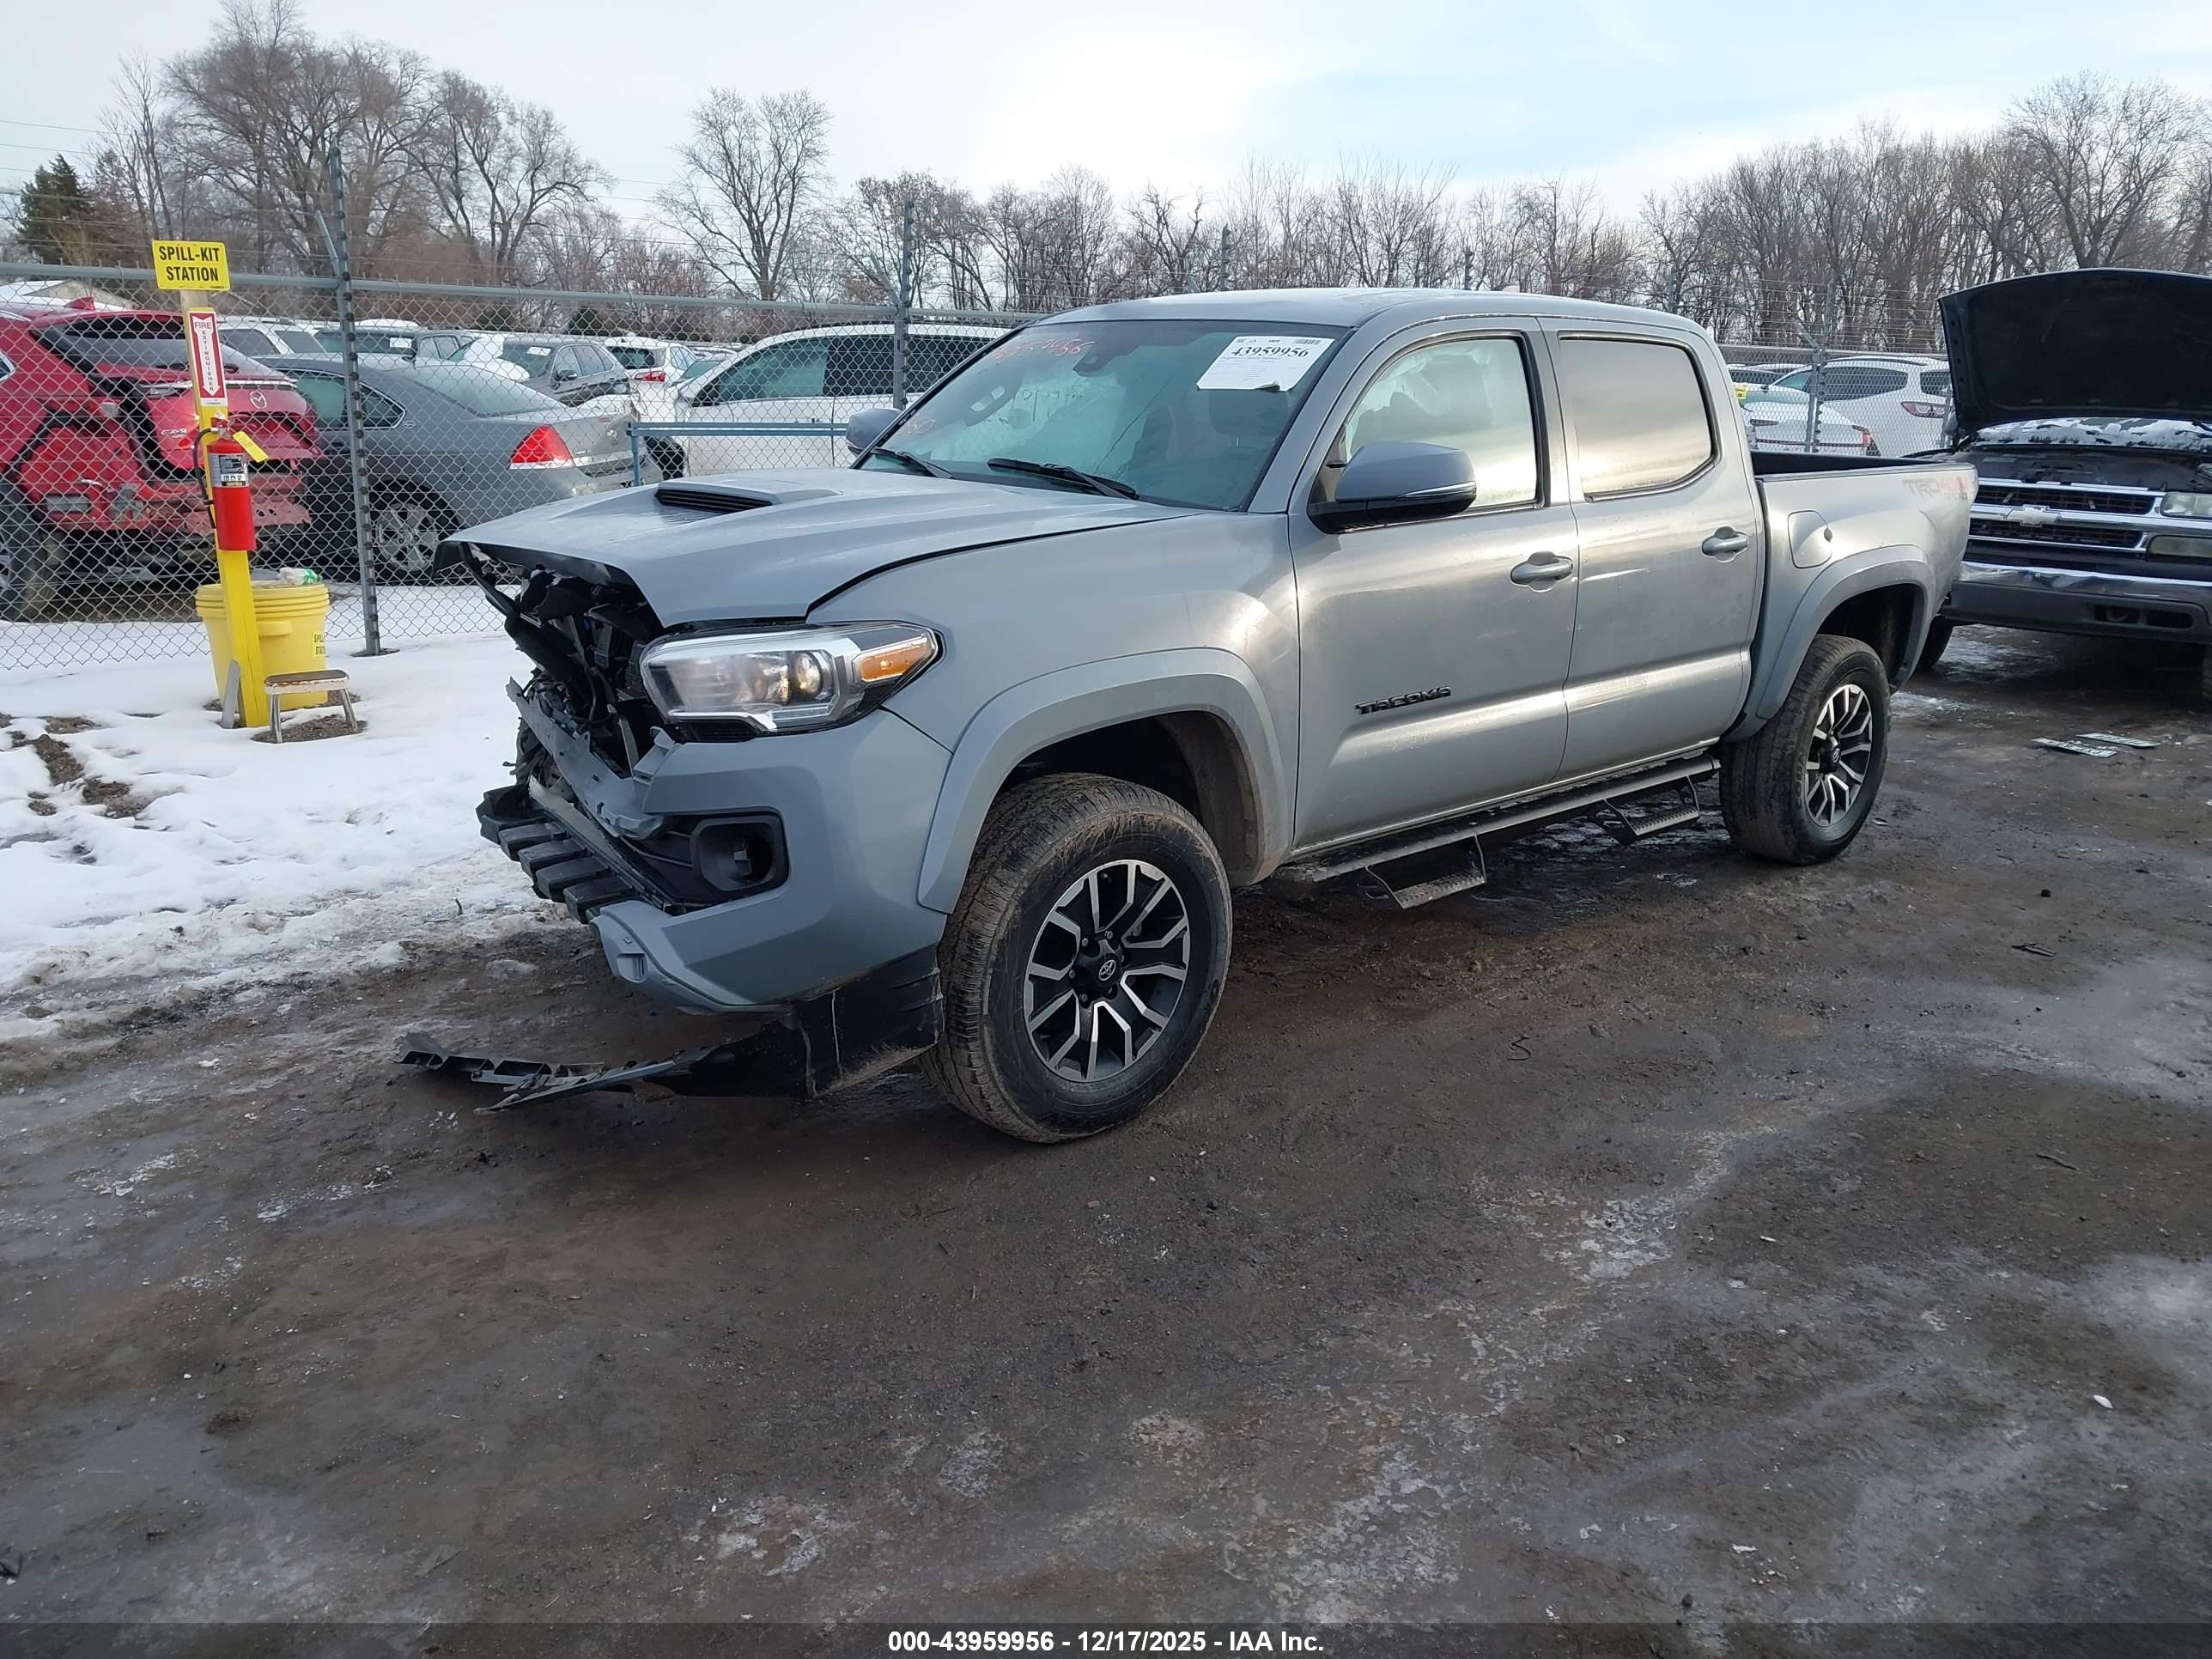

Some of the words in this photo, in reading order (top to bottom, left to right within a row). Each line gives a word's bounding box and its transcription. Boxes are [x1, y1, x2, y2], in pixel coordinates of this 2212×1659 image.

[158, 246, 220, 262] SPILL-KIT
[166, 266, 219, 282] STATION
[194, 321, 212, 330] FIRE
[1231, 346, 1312, 358] 43959956
[202, 330, 215, 392] EXTINGUISHER
[1354, 685, 1452, 715] TACOMA
